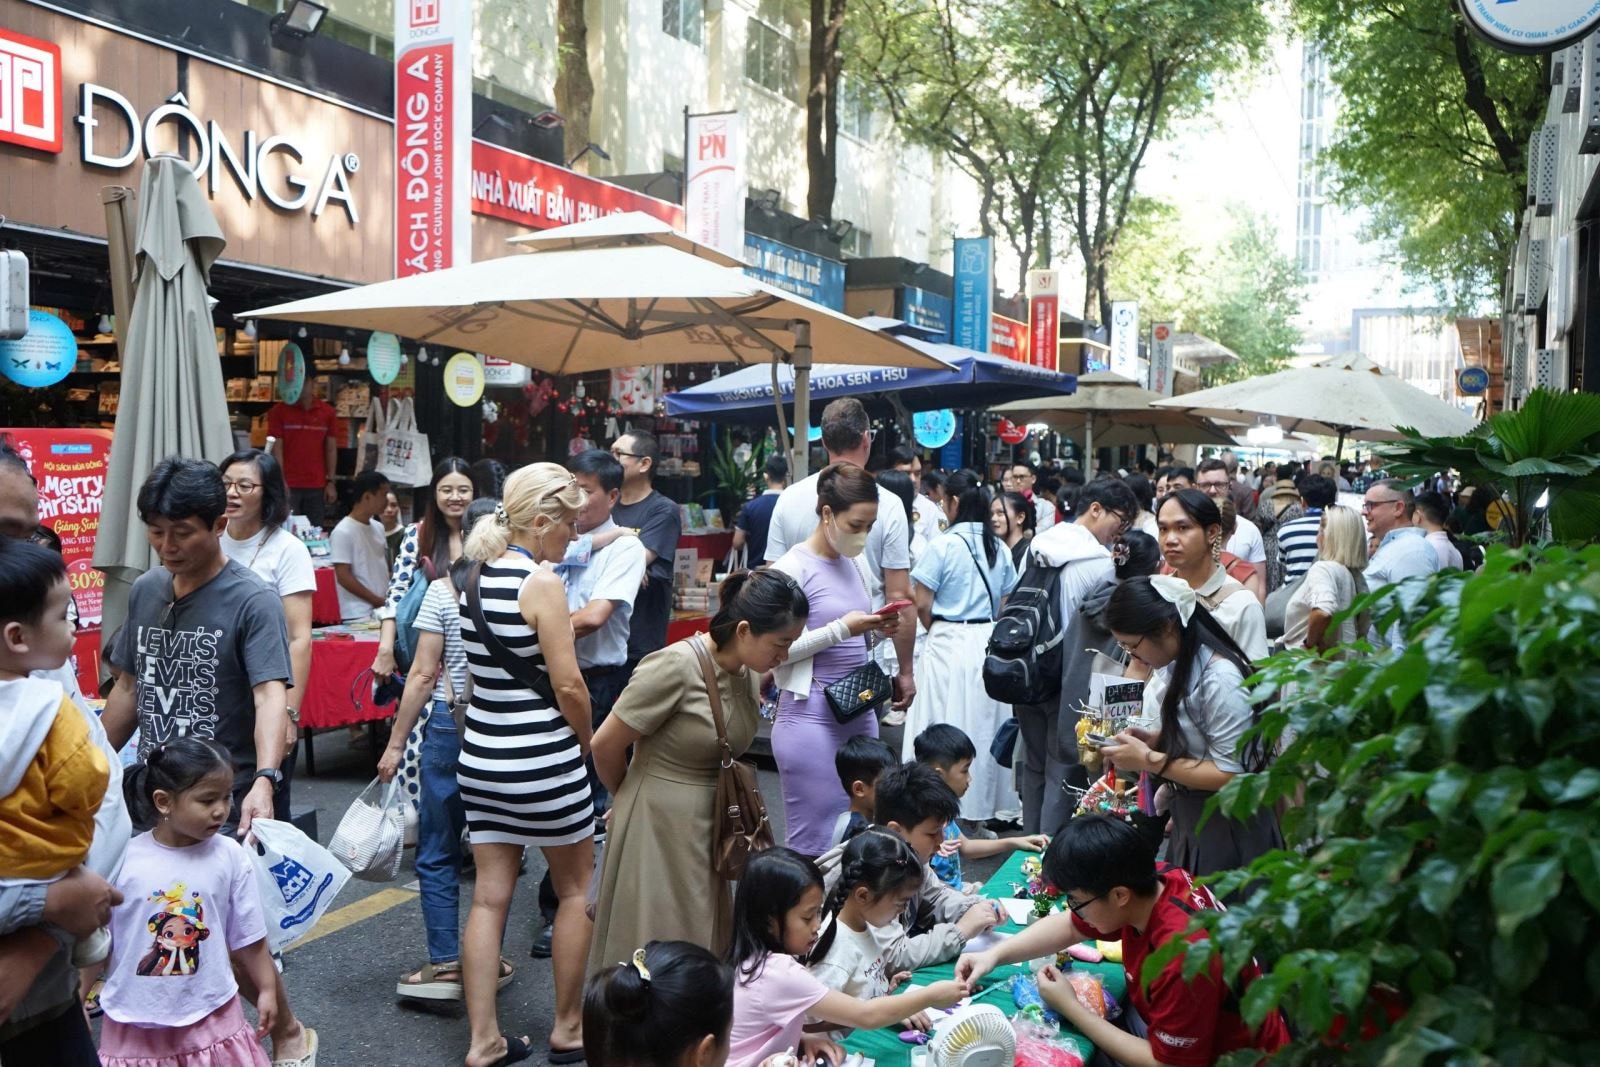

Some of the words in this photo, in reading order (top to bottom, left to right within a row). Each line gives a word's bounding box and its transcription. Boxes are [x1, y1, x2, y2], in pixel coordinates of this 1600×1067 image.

[1524, 30, 1549, 39] QUAN
[1567, 14, 1588, 31] GIAO
[405, 54, 430, 82] A
[434, 53, 444, 113] COMPANY
[433, 115, 444, 151] STOCK
[400, 92, 430, 203] ĐÔNG
[698, 134, 727, 161] PN
[434, 154, 444, 181] JOIN
[433, 183, 444, 236] CULTURAL
[471, 170, 504, 206] NHÀ
[508, 176, 544, 216] XUẤT
[546, 184, 575, 225] BẢN
[404, 212, 429, 274] ÁCH
[817, 375, 846, 391] HOA
[846, 371, 872, 387] SEN
[881, 367, 908, 383] HSU
[43, 475, 103, 498] Merry
[54, 518, 81, 538] Giáng
[69, 570, 105, 590] 30%
[1110, 704, 1134, 718] CLAY
